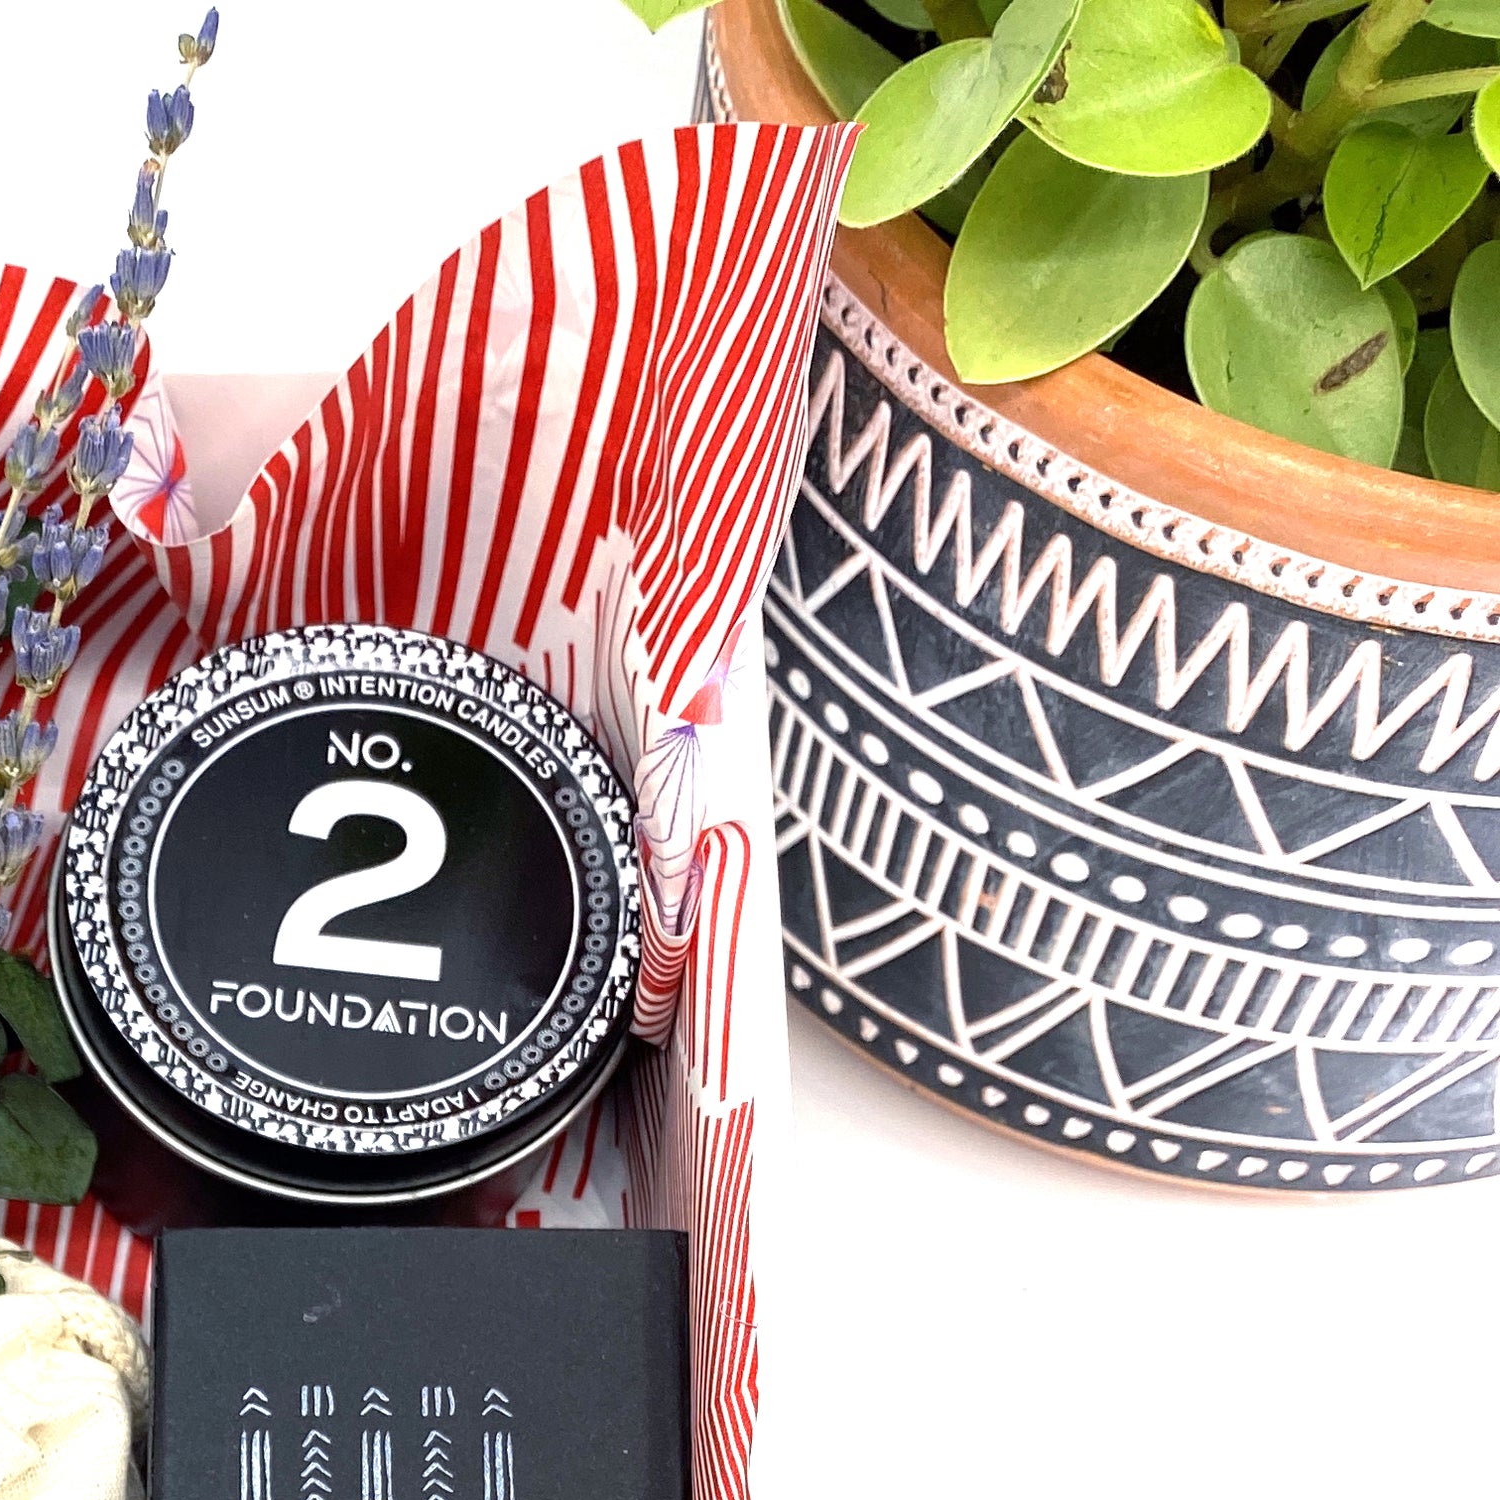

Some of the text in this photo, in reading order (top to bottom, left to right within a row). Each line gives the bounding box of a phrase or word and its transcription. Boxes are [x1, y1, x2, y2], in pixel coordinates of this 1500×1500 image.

[190, 685, 291, 748] SUNSUM
[319, 675, 455, 712] INTENTION
[457, 699, 558, 780] CANDLES
[327, 730, 413, 772] NO.
[273, 779, 446, 982] 2
[209, 979, 508, 1045] FOUNDATION
[233, 1070, 480, 1124] I ADAPT TO CHANGE
